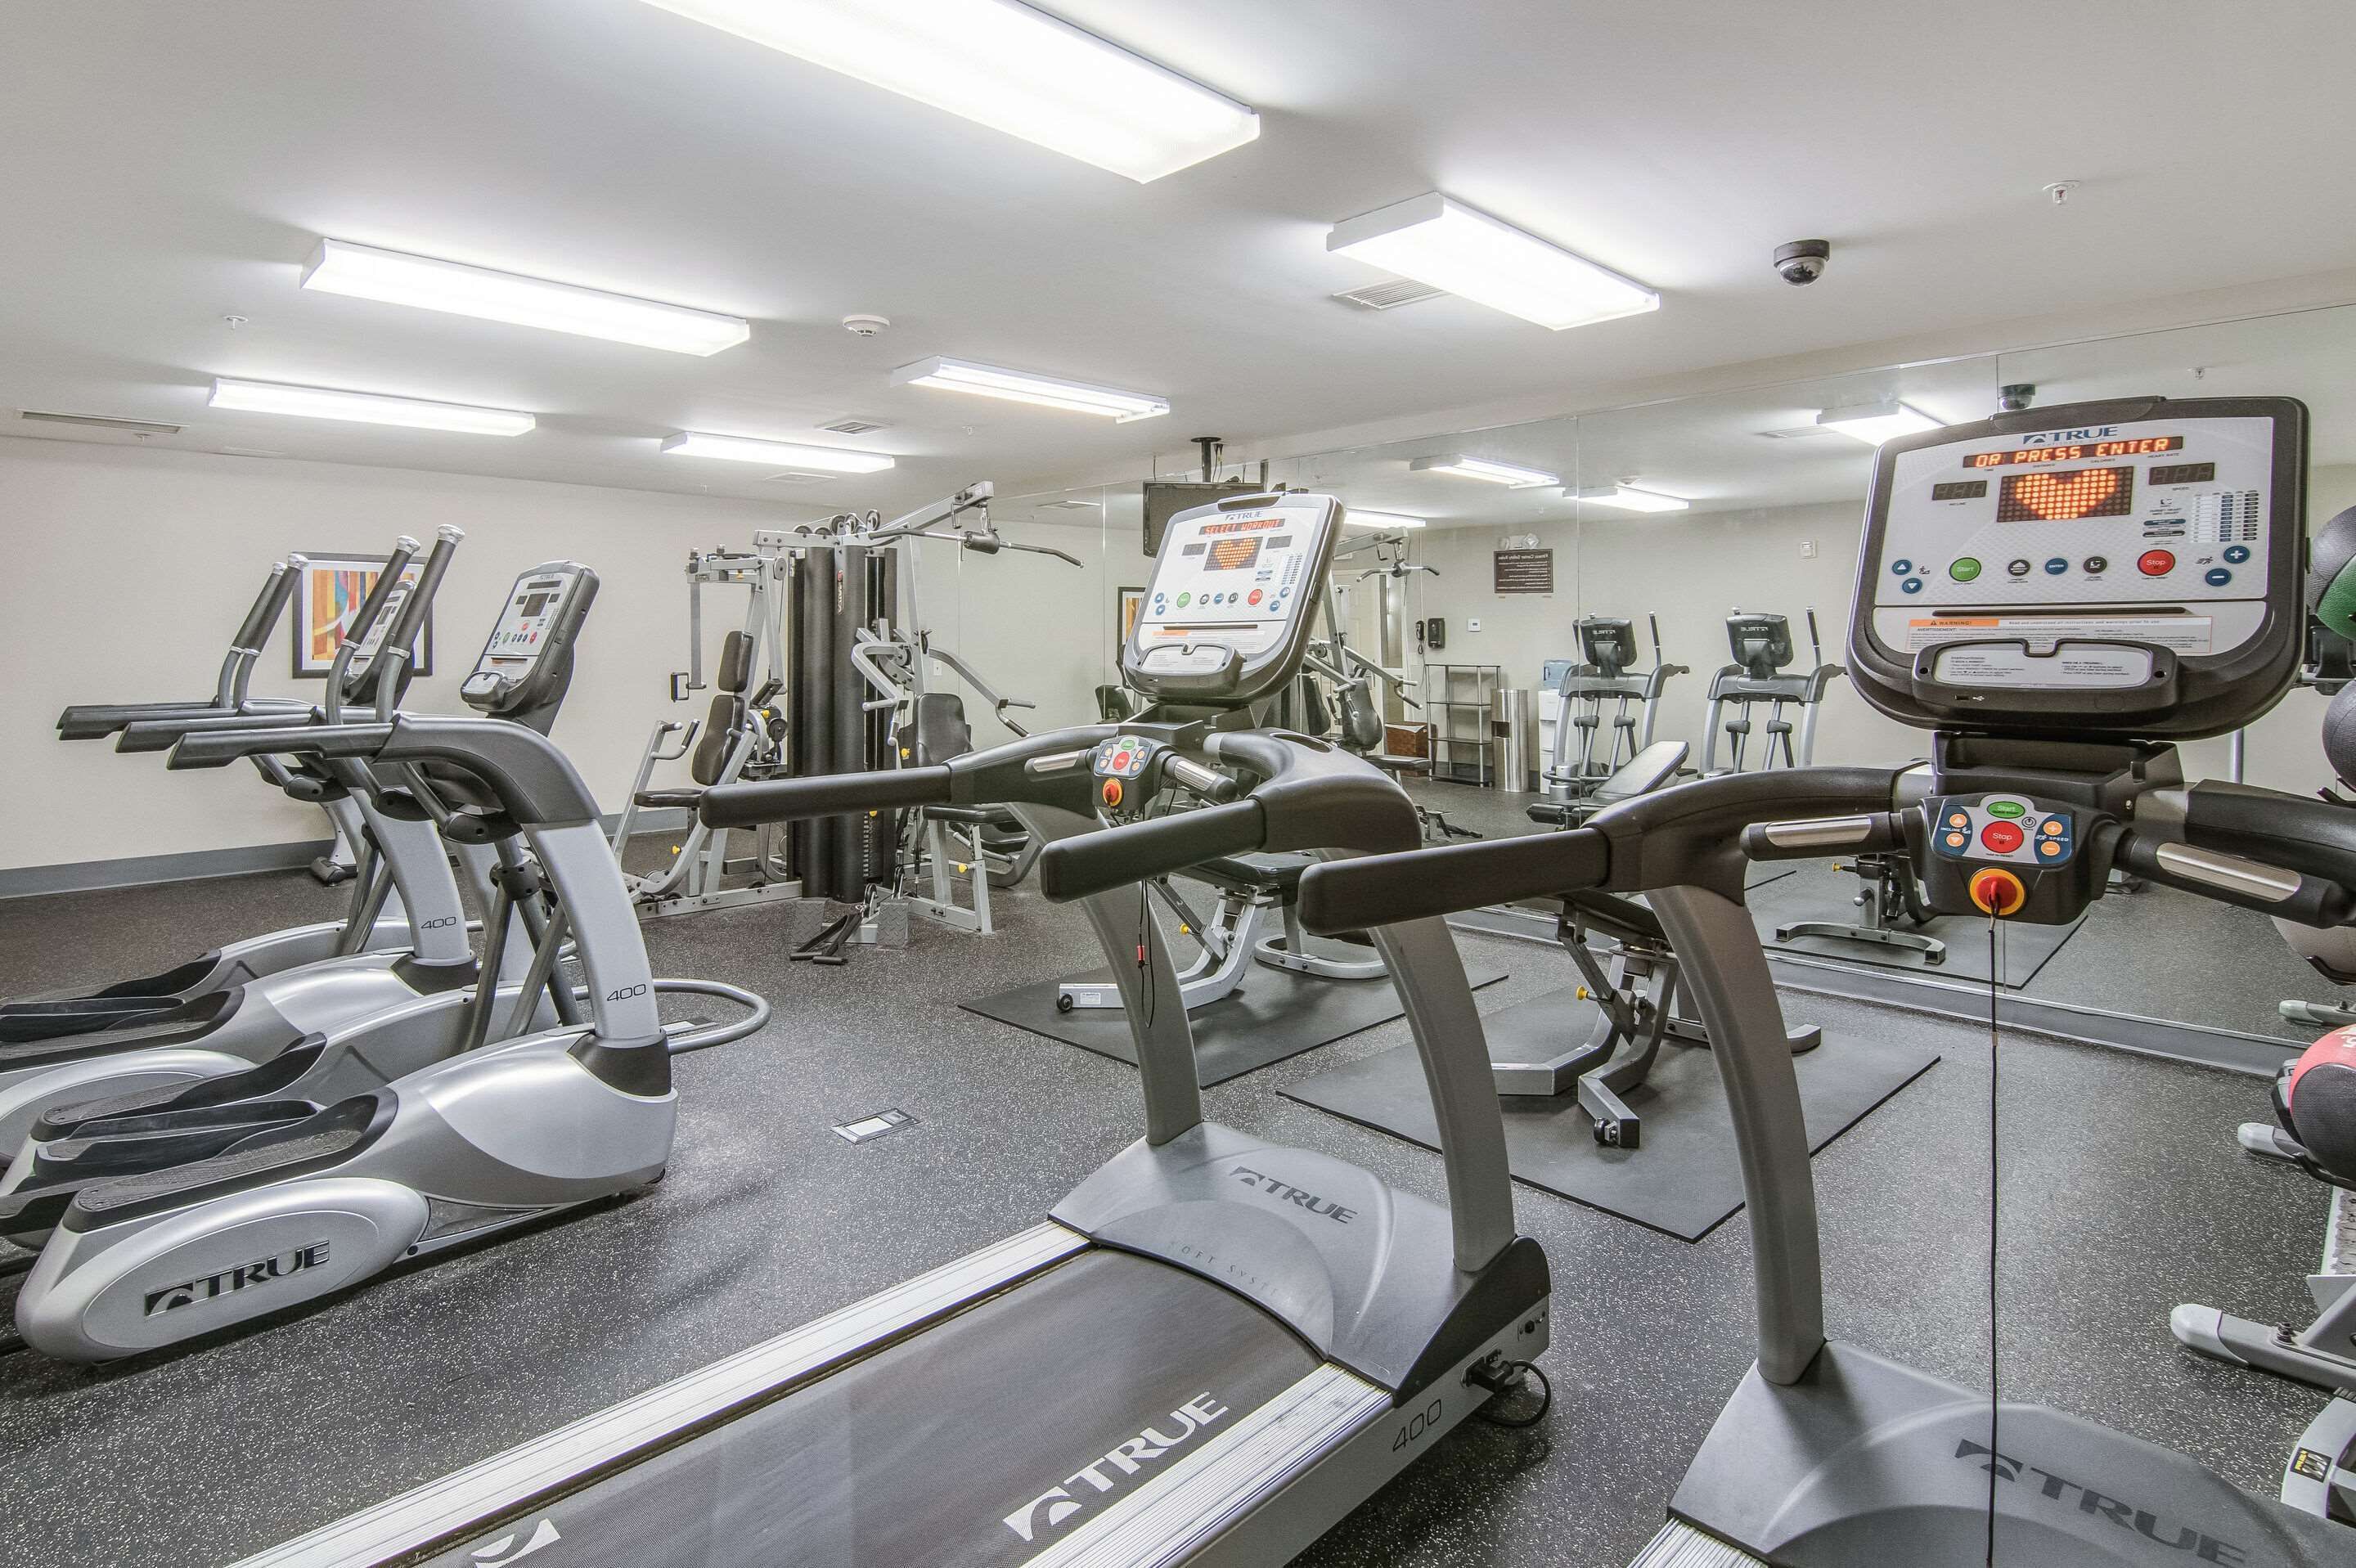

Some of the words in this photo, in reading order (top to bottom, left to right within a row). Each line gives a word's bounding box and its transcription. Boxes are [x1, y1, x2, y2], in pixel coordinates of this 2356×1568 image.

[2048, 426, 2118, 442] TRUE
[1976, 453, 2001, 467] OR
[2015, 446, 2080, 463] PRESS
[2096, 438, 2169, 456] ENTER
[1237, 510, 1264, 520] TRUE
[1205, 523, 1237, 535] SELECT
[1241, 519, 1280, 532] WORKOUT
[1992, 833, 2012, 841] Stop
[420, 916, 456, 929] 400
[607, 984, 646, 1002] 400
[1266, 1178, 1358, 1224] TRUE
[196, 1240, 330, 1297] TRUE
[1392, 1399, 1442, 1453] 400
[1064, 1391, 1229, 1492] TRUE
[2030, 1467, 2246, 1568] TRUE
